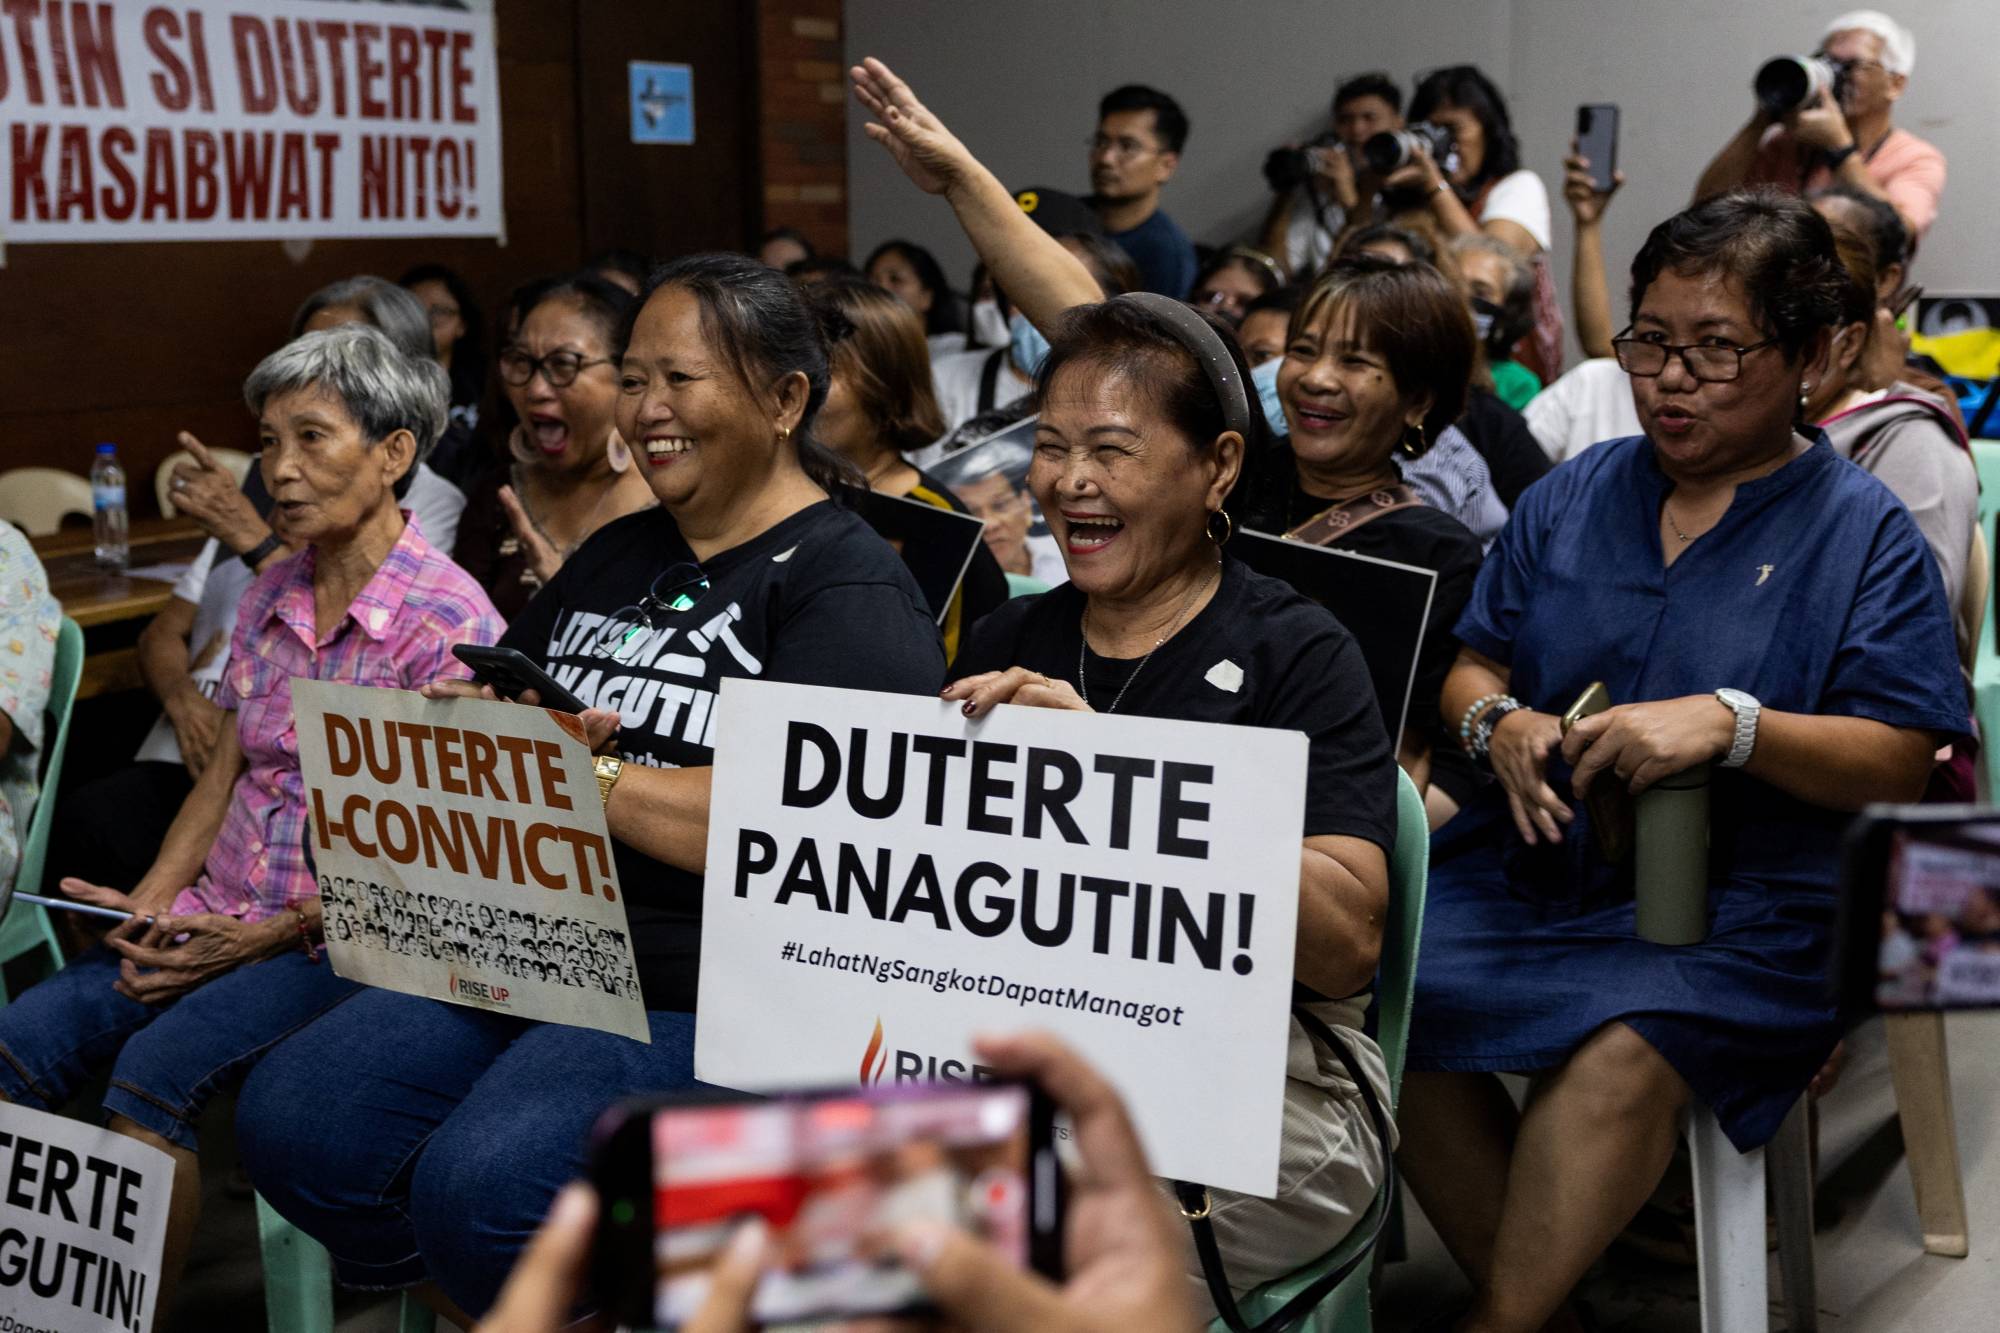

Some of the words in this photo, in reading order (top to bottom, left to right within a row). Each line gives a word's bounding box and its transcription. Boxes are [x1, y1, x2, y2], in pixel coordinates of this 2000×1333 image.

[0, 0, 126, 109] TIN
[143, 7, 215, 112] SI
[230, 14, 477, 123] DUTERTE
[10, 122, 340, 222] KASABWAT
[360, 134, 478, 221] NITO!
[546, 662, 719, 749] NAGUTI
[323, 712, 574, 811] DUTERTE
[781, 720, 1214, 860] DUTERTE
[312, 788, 616, 902] I-CONVICT!
[734, 828, 1256, 976] PANAGUTIN!
[459, 979, 489, 998] RISE
[490, 986, 509, 1001] UP
[781, 941, 1184, 1028] #LahatNgSangkotDapatManagot
